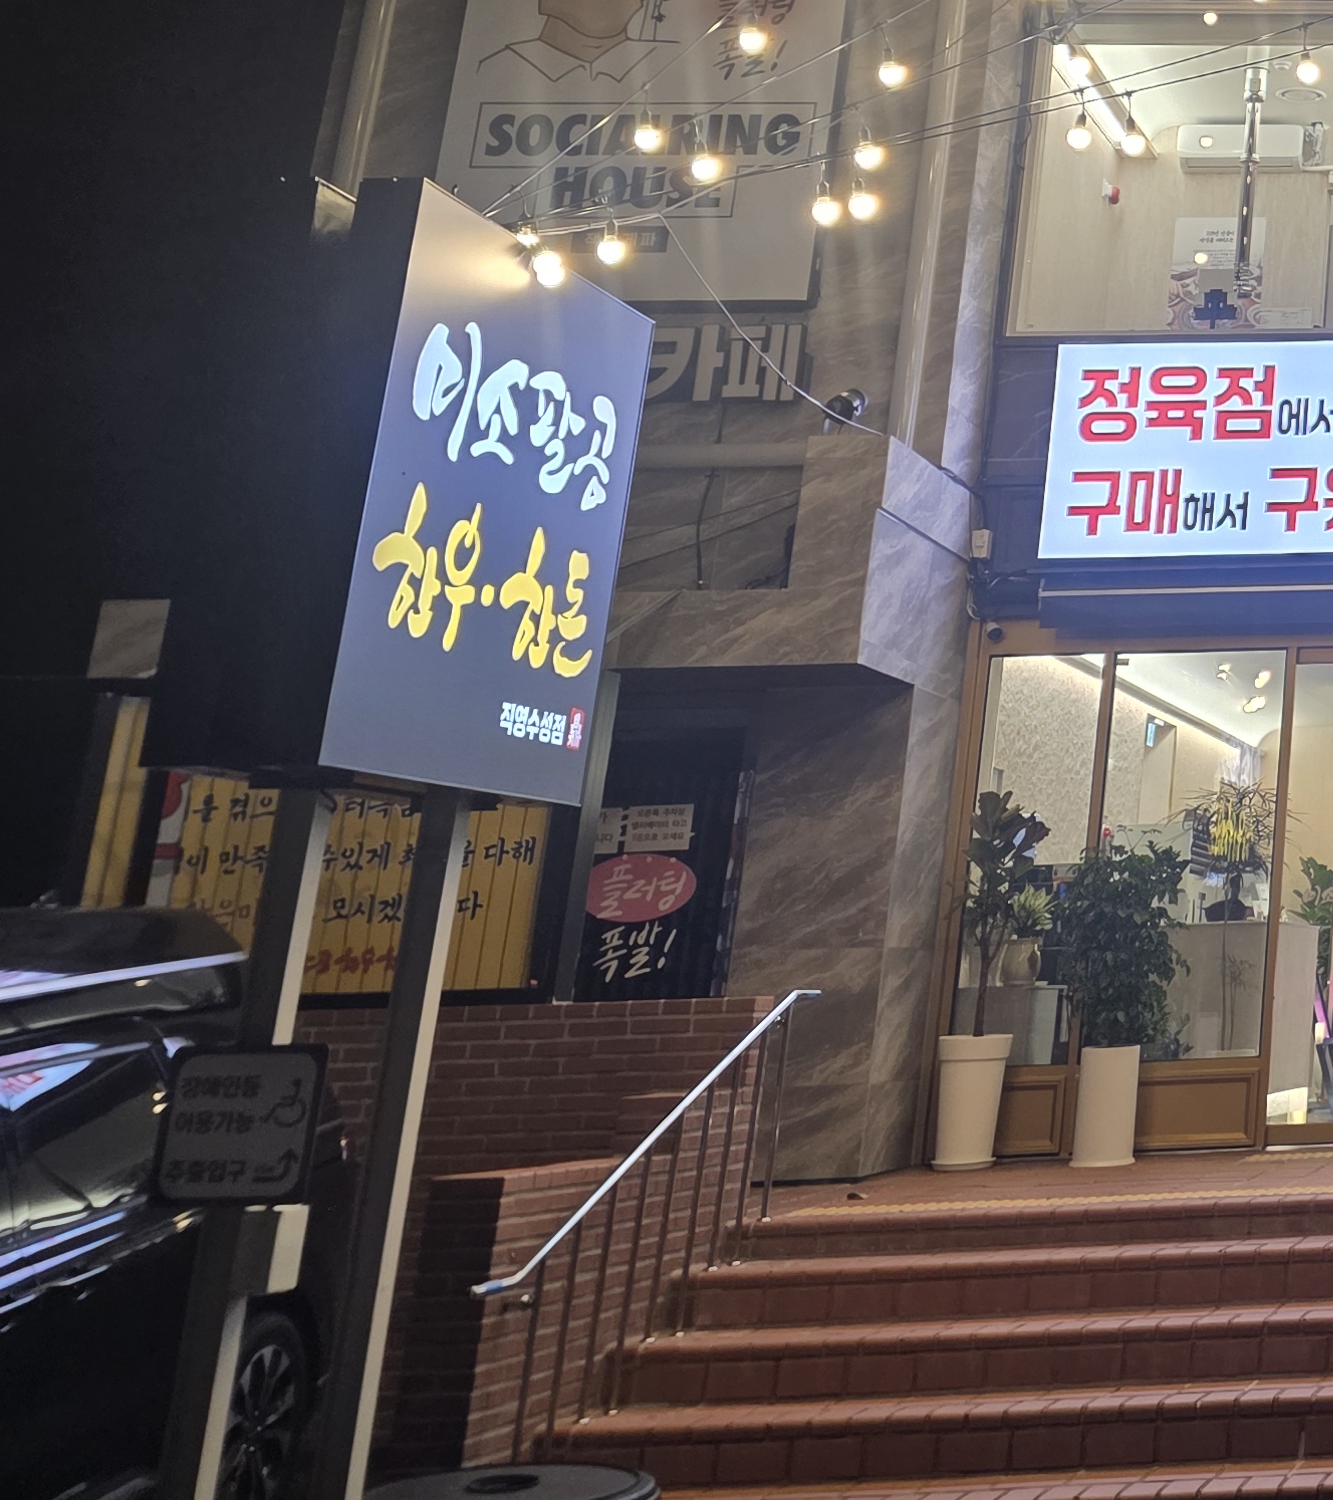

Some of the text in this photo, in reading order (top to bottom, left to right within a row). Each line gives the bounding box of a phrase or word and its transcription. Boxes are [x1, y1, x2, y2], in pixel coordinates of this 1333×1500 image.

[1065, 466, 1250, 537] 구매해서
[499, 701, 567, 746] 직영수성점
[484, 836, 537, 867] 다해
[596, 864, 686, 918] 플러팅
[593, 921, 677, 983] 폭발!
